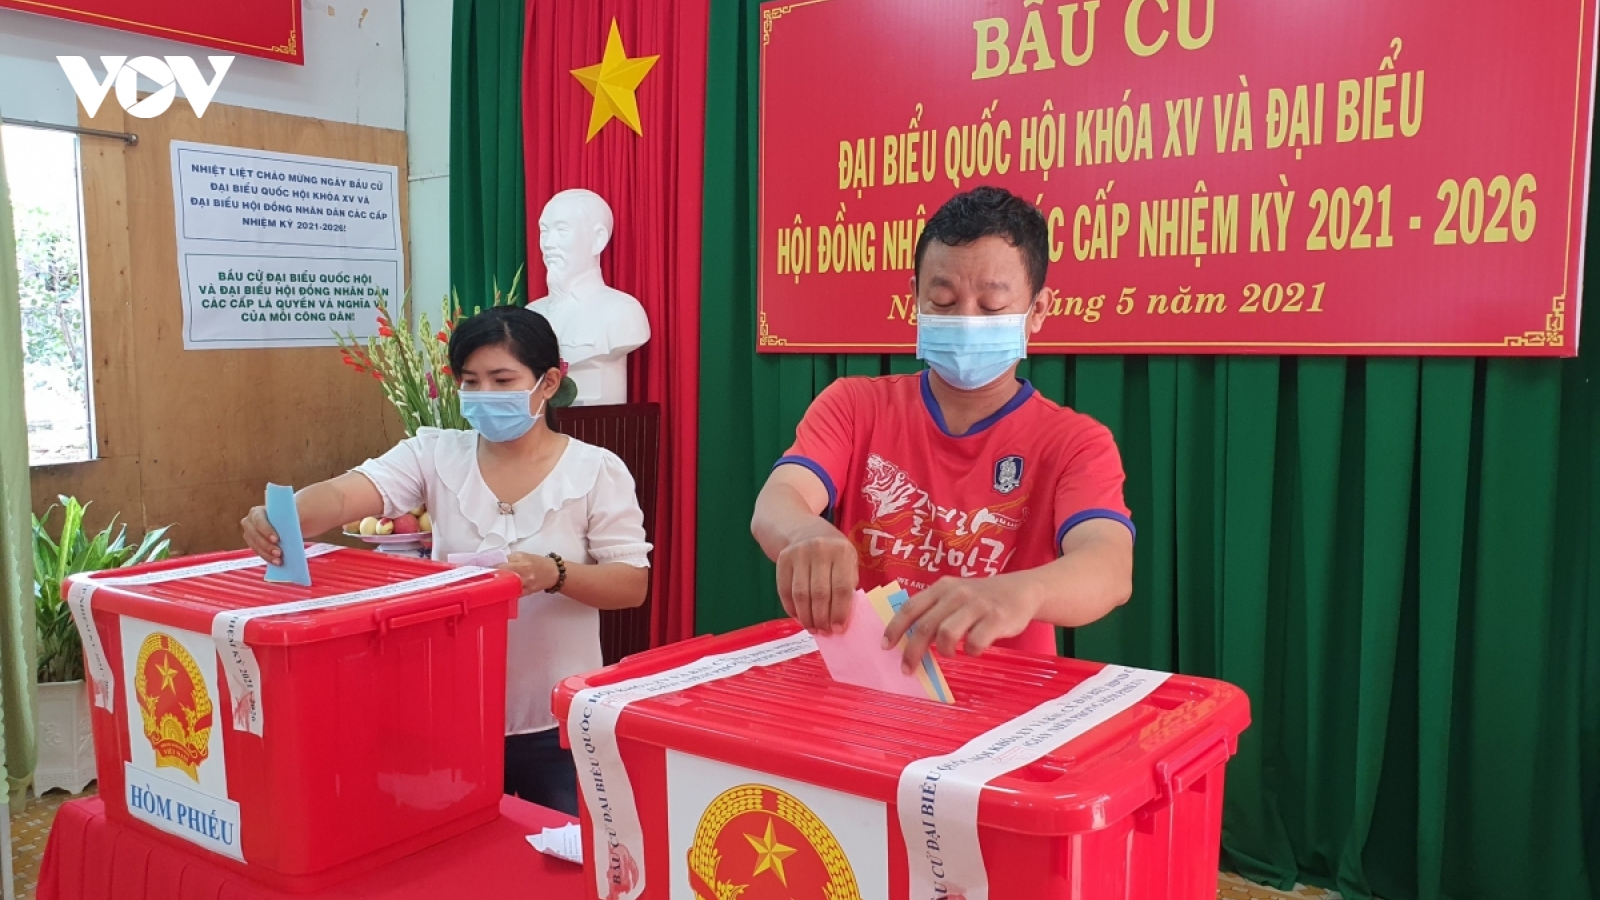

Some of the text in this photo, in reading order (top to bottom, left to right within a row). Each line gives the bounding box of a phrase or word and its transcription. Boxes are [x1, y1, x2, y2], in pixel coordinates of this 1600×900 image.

[839, 37, 1425, 199] ĐẠI BIỂU QUỐC HỘI KHÓA XV VÀ ĐẠI BIỂU
[191, 164, 226, 177] NHIỆT
[229, 167, 253, 180] LIỆT
[210, 182, 229, 194] ĐẠI
[233, 182, 258, 194] BIỂU
[261, 186, 290, 197] QUỐC
[292, 189, 310, 201] HỘI
[313, 191, 340, 201] KHÓA
[342, 195, 355, 203] XV
[190, 197, 210, 209] ĐẠI
[213, 196, 239, 208] BIỂU
[242, 200, 260, 212] HỘI
[242, 216, 277, 229] NHIỆM
[776, 213, 812, 284] HỘI
[817, 202, 876, 274] ĐỒNG
[1072, 180, 1130, 262] CẤP
[1138, 180, 1239, 268] NHIỆM
[1249, 174, 1295, 253] KỲ
[1306, 184, 1394, 251] 2021
[1409, 216, 1422, 230] -
[1433, 173, 1537, 245] 2026
[247, 269, 264, 282] CỬ
[266, 273, 286, 285] ĐẠI
[290, 270, 316, 282] BIỂU
[319, 271, 350, 282] QUỐC
[353, 273, 372, 286] HỘI
[199, 283, 216, 295] VÀ
[219, 285, 240, 297] ĐẠI
[244, 282, 272, 295] BIỂU
[275, 284, 296, 298] HỘI
[334, 286, 364, 296] NHÂN
[1116, 287, 1137, 316] 5
[1146, 286, 1227, 314] năm
[1239, 281, 1327, 314] 2021
[201, 296, 227, 308] CÁC
[230, 295, 254, 308] CẤP
[258, 297, 272, 308] LÀ
[319, 298, 333, 308] VÀ
[337, 297, 371, 308] NGHĨA
[241, 309, 267, 322] CỦA
[294, 311, 326, 322] CÔNG
[919, 770, 941, 816] BIỂU
[131, 783, 234, 846] HÒM PHIẾU
[599, 797, 613, 823] ĐẠI
[923, 821, 940, 852] ĐẠI
